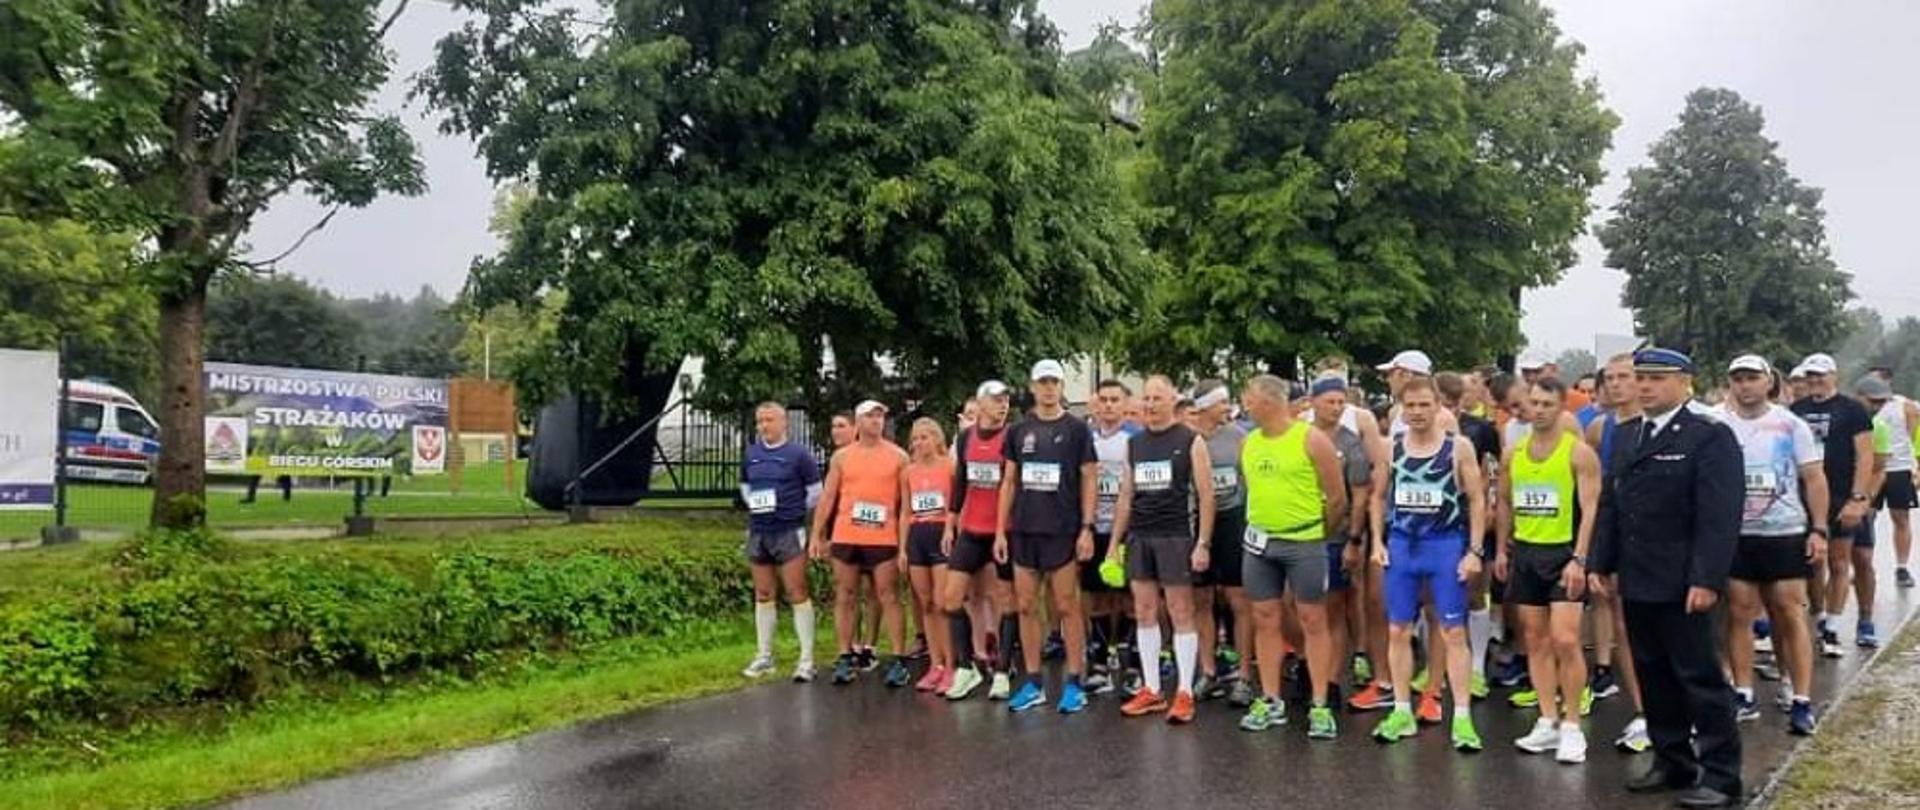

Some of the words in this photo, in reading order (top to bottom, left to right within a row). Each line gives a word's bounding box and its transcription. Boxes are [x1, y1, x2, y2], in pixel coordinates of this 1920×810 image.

[209, 373, 370, 398] MISTRZOSTWA
[375, 384, 443, 403] POLSKI
[255, 405, 405, 430] STRAŻAKÓW
[269, 455, 318, 467] BIEGU
[322, 456, 393, 468] GÓRSKIM
